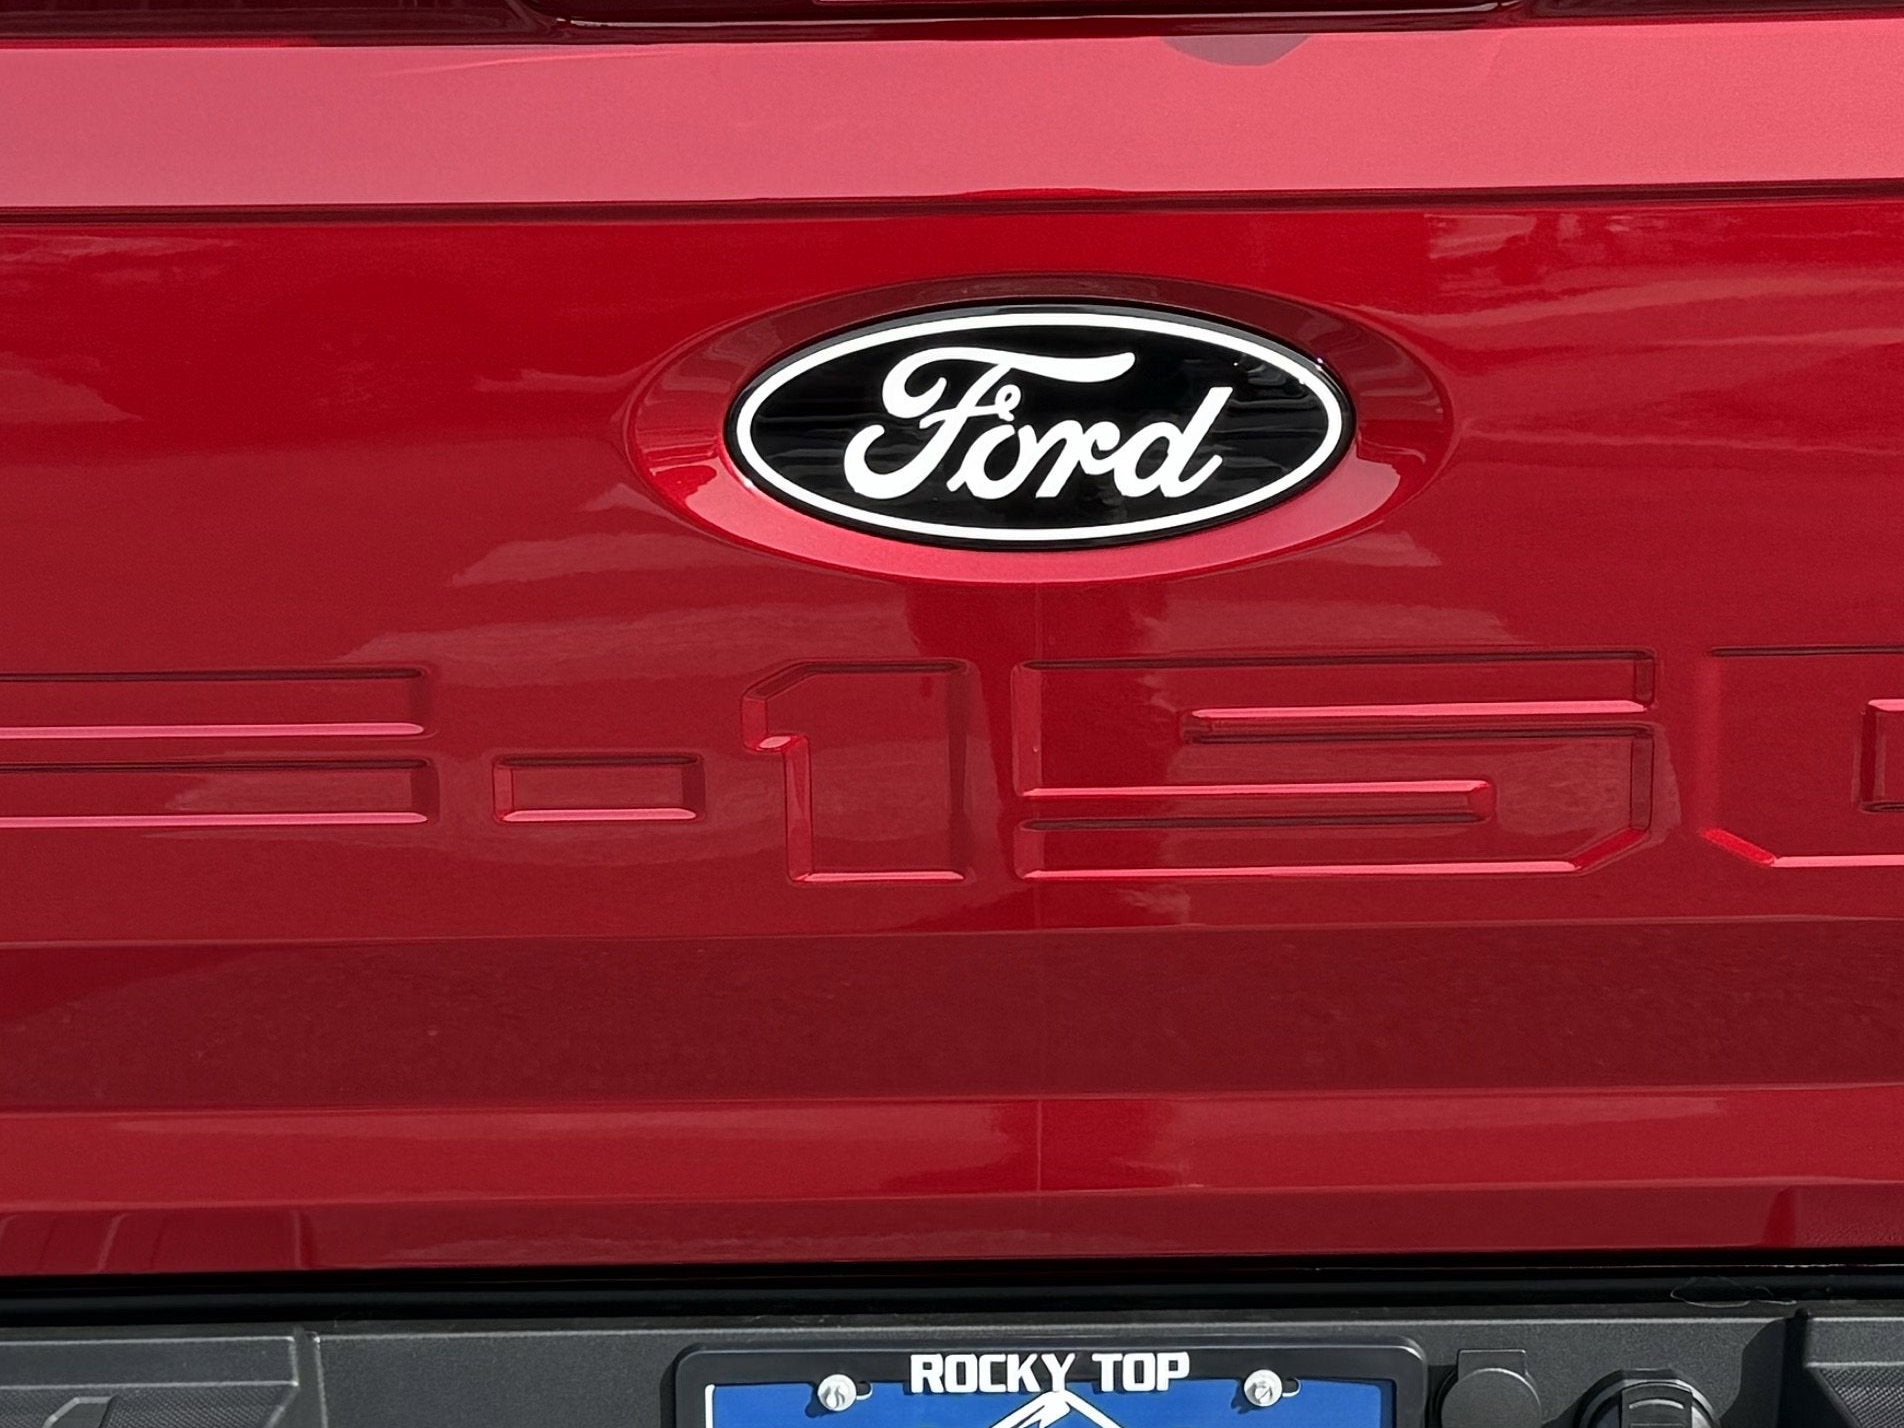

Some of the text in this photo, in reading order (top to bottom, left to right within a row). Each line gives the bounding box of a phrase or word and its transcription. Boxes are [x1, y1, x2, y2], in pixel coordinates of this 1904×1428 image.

[843, 346, 1223, 500] Ford
[909, 1352, 1190, 1393] ROCKY TOP
